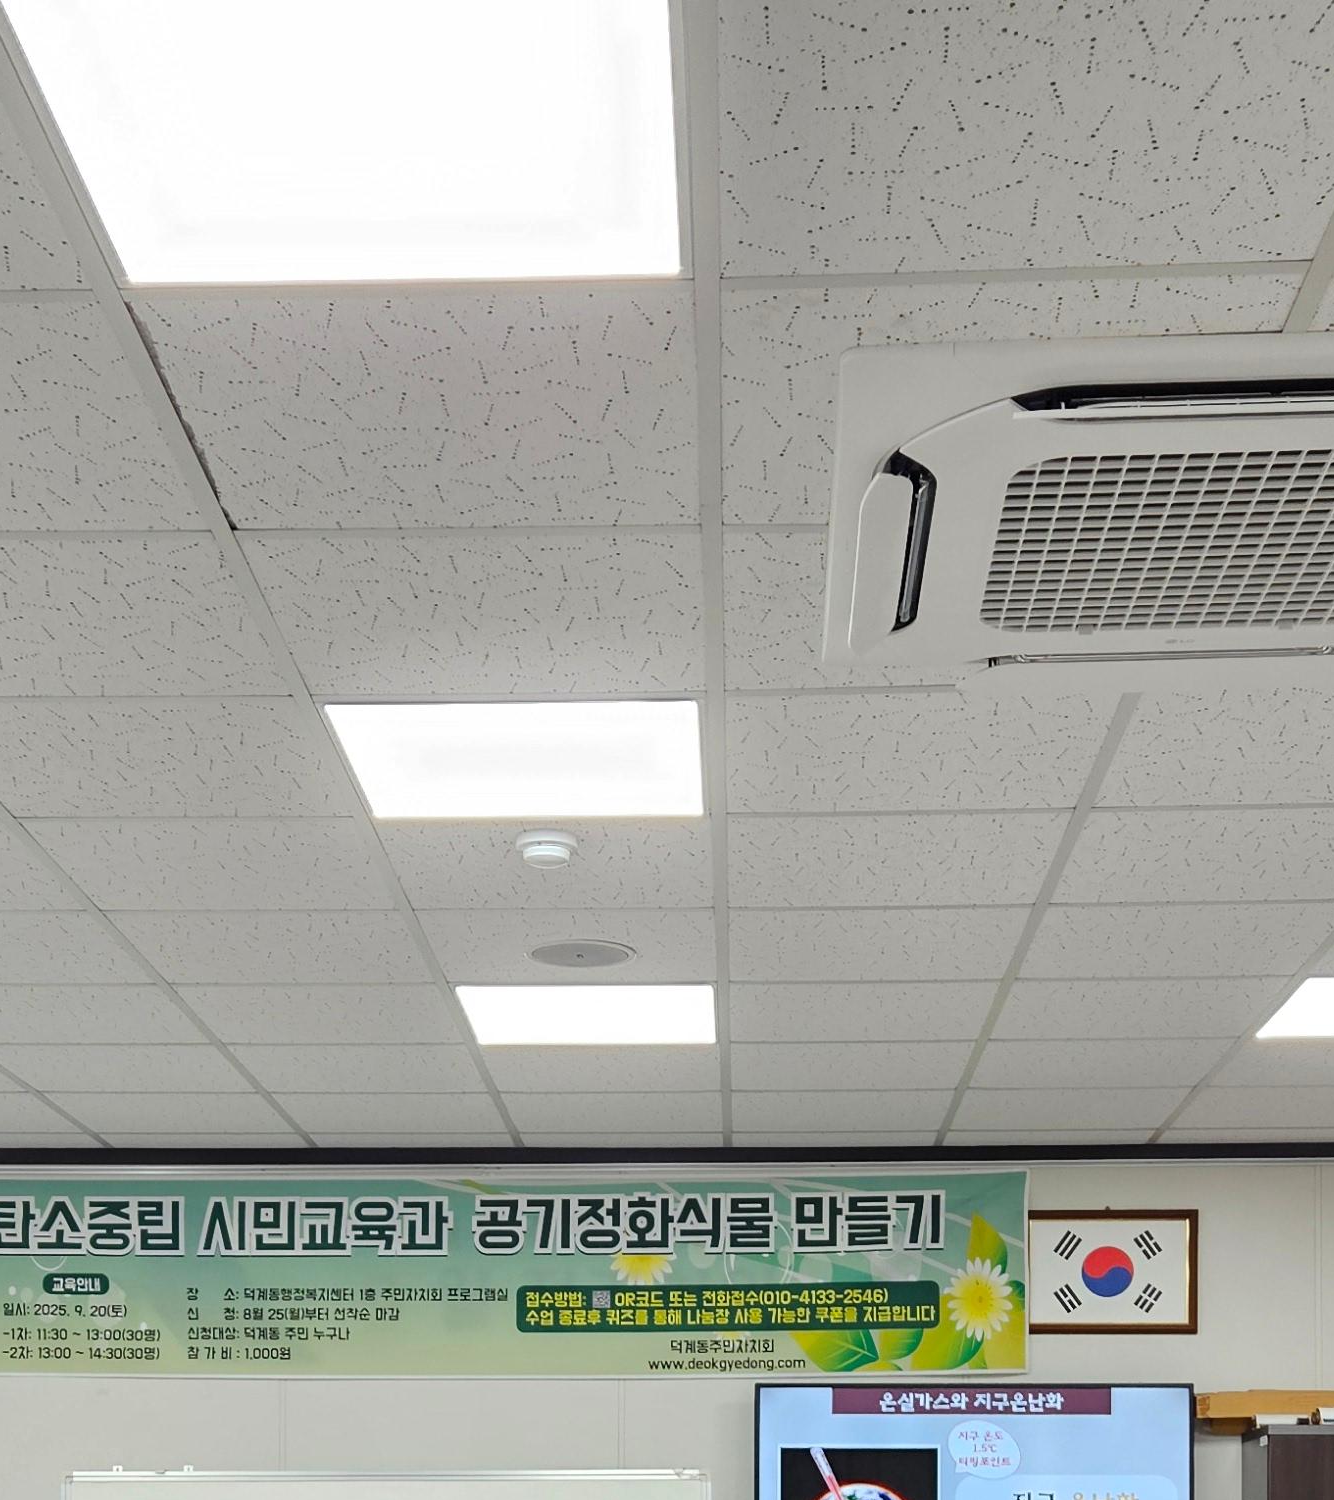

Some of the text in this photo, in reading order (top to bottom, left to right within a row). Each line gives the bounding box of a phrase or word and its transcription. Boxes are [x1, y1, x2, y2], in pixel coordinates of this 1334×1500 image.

[198, 1197, 453, 1255] 시민교육과
[472, 1194, 777, 1254] 공기정화식물
[792, 1191, 946, 1251] 만들기
[52, 1278, 100, 1291] 교육안내
[187, 1288, 198, 1300] 장
[244, 1288, 353, 1301] 덕계동행정복지센터
[360, 1288, 375, 1301] 1층
[381, 1288, 442, 1301] 주민자치회
[448, 1288, 507, 1301] 프로그램실
[525, 1291, 587, 1308] 접수방법:
[669, 1291, 699, 1310] 또는
[702, 1288, 888, 1308] 전화접수(010-4133-2546)
[3, 1303, 127, 1317] 일시: 2025. 9. 20(토)
[188, 1308, 198, 1320] 신
[244, 1308, 263, 1320] 8월
[268, 1308, 328, 1320] 25(월)부터
[335, 1308, 370, 1320] 선착순
[376, 1308, 399, 1320] 마감
[526, 1310, 553, 1325] 수업
[559, 1310, 601, 1325] 종료후
[606, 1309, 648, 1326] 퀴즈를
[654, 1309, 681, 1325] 통해
[735, 1308, 762, 1324] 사용
[768, 1308, 810, 1323] 가능한
[816, 1307, 857, 1323] 쿠폰을
[863, 1306, 936, 1323] 지급합니다
[3, 1327, 31, 1340] -1차:
[37, 1328, 67, 1340] 11:30
[87, 1329, 160, 1341] 13:00(30명)
[188, 1327, 350, 1340] 신청대상: 덕계동 주민 누구나
[3, 1346, 32, 1359] -2차:
[39, 1347, 71, 1359] 13:00
[89, 1347, 159, 1360] 14:30(30명)
[188, 1346, 199, 1359] 참
[204, 1347, 216, 1359] 가
[221, 1347, 231, 1359] 비
[671, 1339, 774, 1353] 덕계동주민자치회
[648, 1358, 806, 1373] www.deokgyedong.com
[879, 1391, 1065, 1411] 온실가스와 지구온난화
